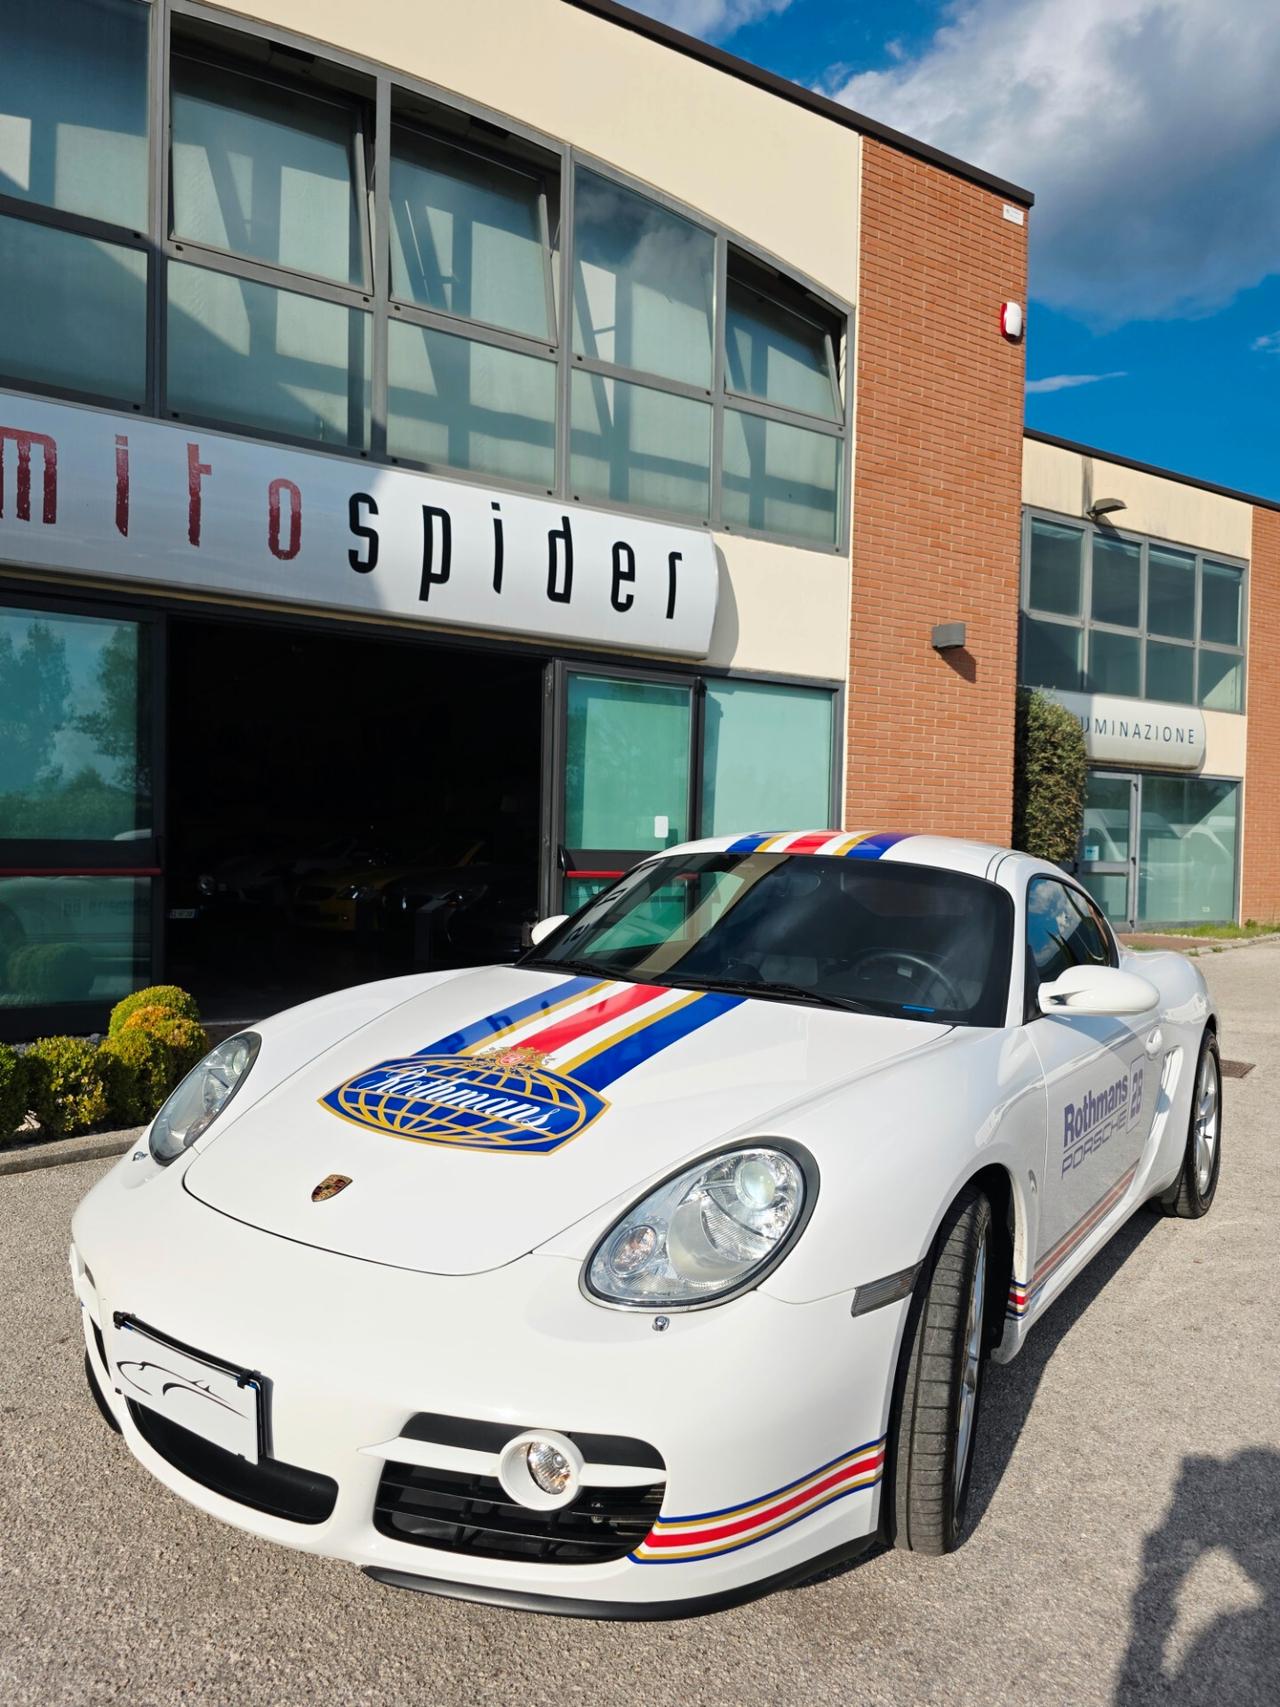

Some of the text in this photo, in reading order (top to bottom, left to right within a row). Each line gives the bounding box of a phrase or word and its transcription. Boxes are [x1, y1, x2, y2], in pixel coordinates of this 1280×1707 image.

[357, 1065, 560, 1131] Rothmans
[1063, 1075, 1128, 1148] Rothmans
[1061, 1108, 1127, 1180] PORSCHE
